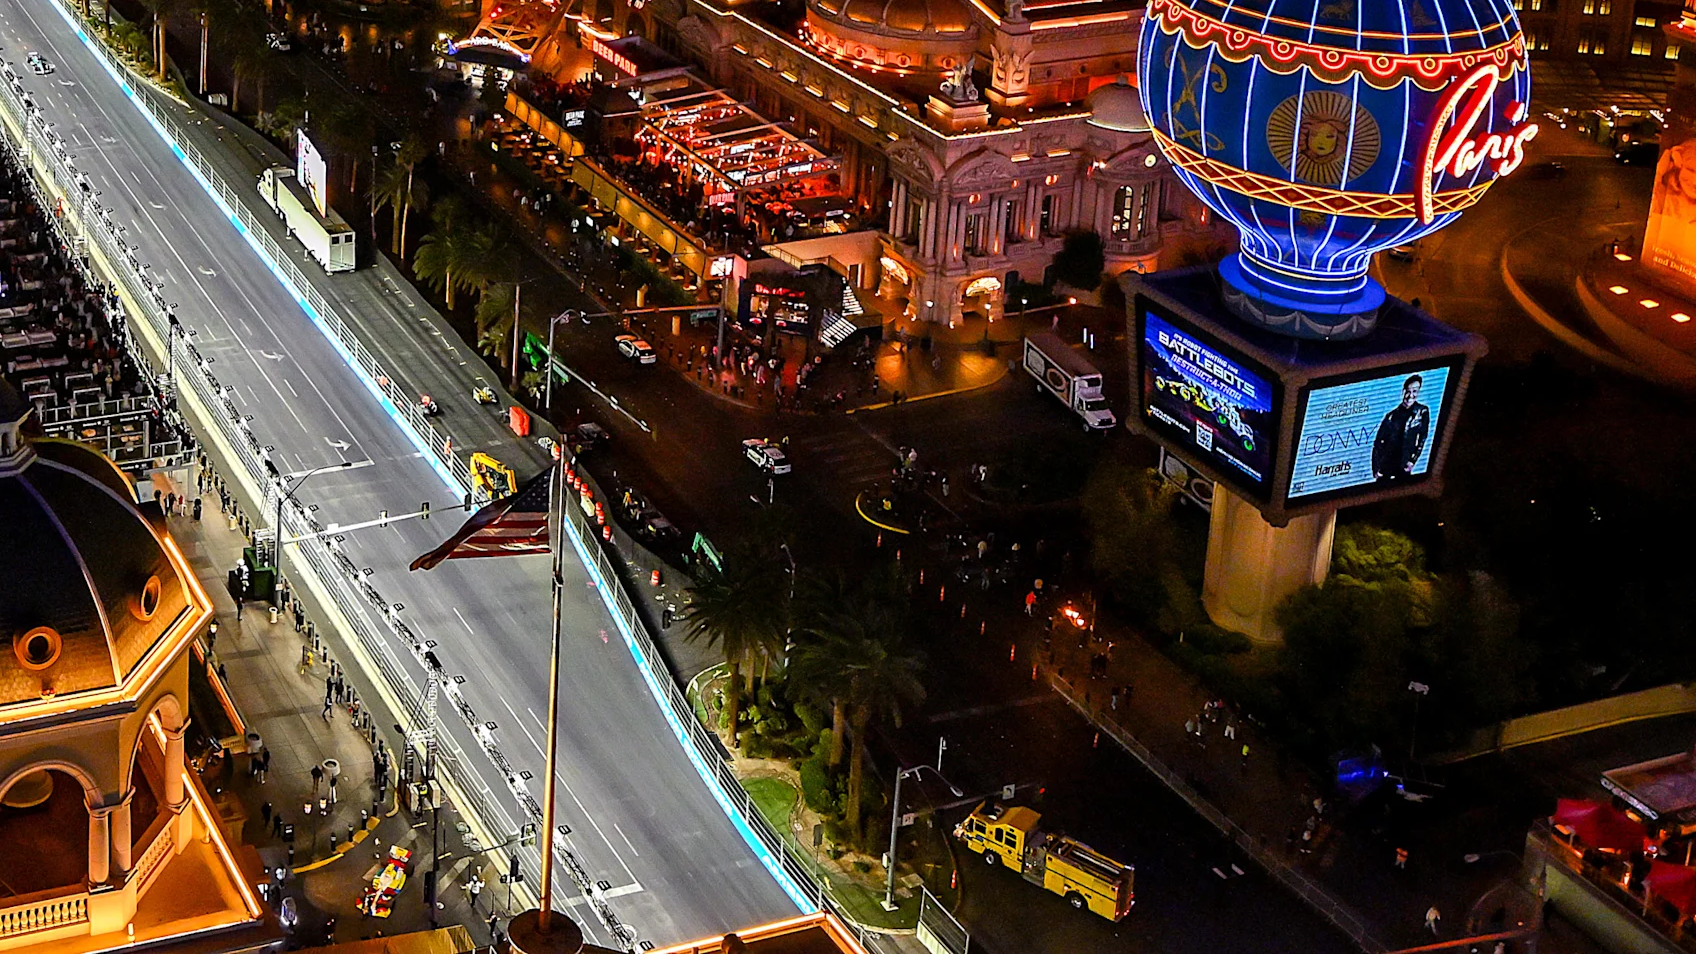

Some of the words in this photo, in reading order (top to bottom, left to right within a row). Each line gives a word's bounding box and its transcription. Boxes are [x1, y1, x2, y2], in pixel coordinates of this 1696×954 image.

[592, 39, 614, 63] BEER
[613, 51, 639, 77] PARK
[1423, 63, 1539, 226] Paris
[1182, 337, 1202, 353] ROBOT
[1201, 349, 1228, 368] FIGHTING
[1170, 353, 1243, 401] DESTRUCT-A-THON
[1325, 398, 1368, 412] GREATEST
[1304, 424, 1379, 457] DONNY
